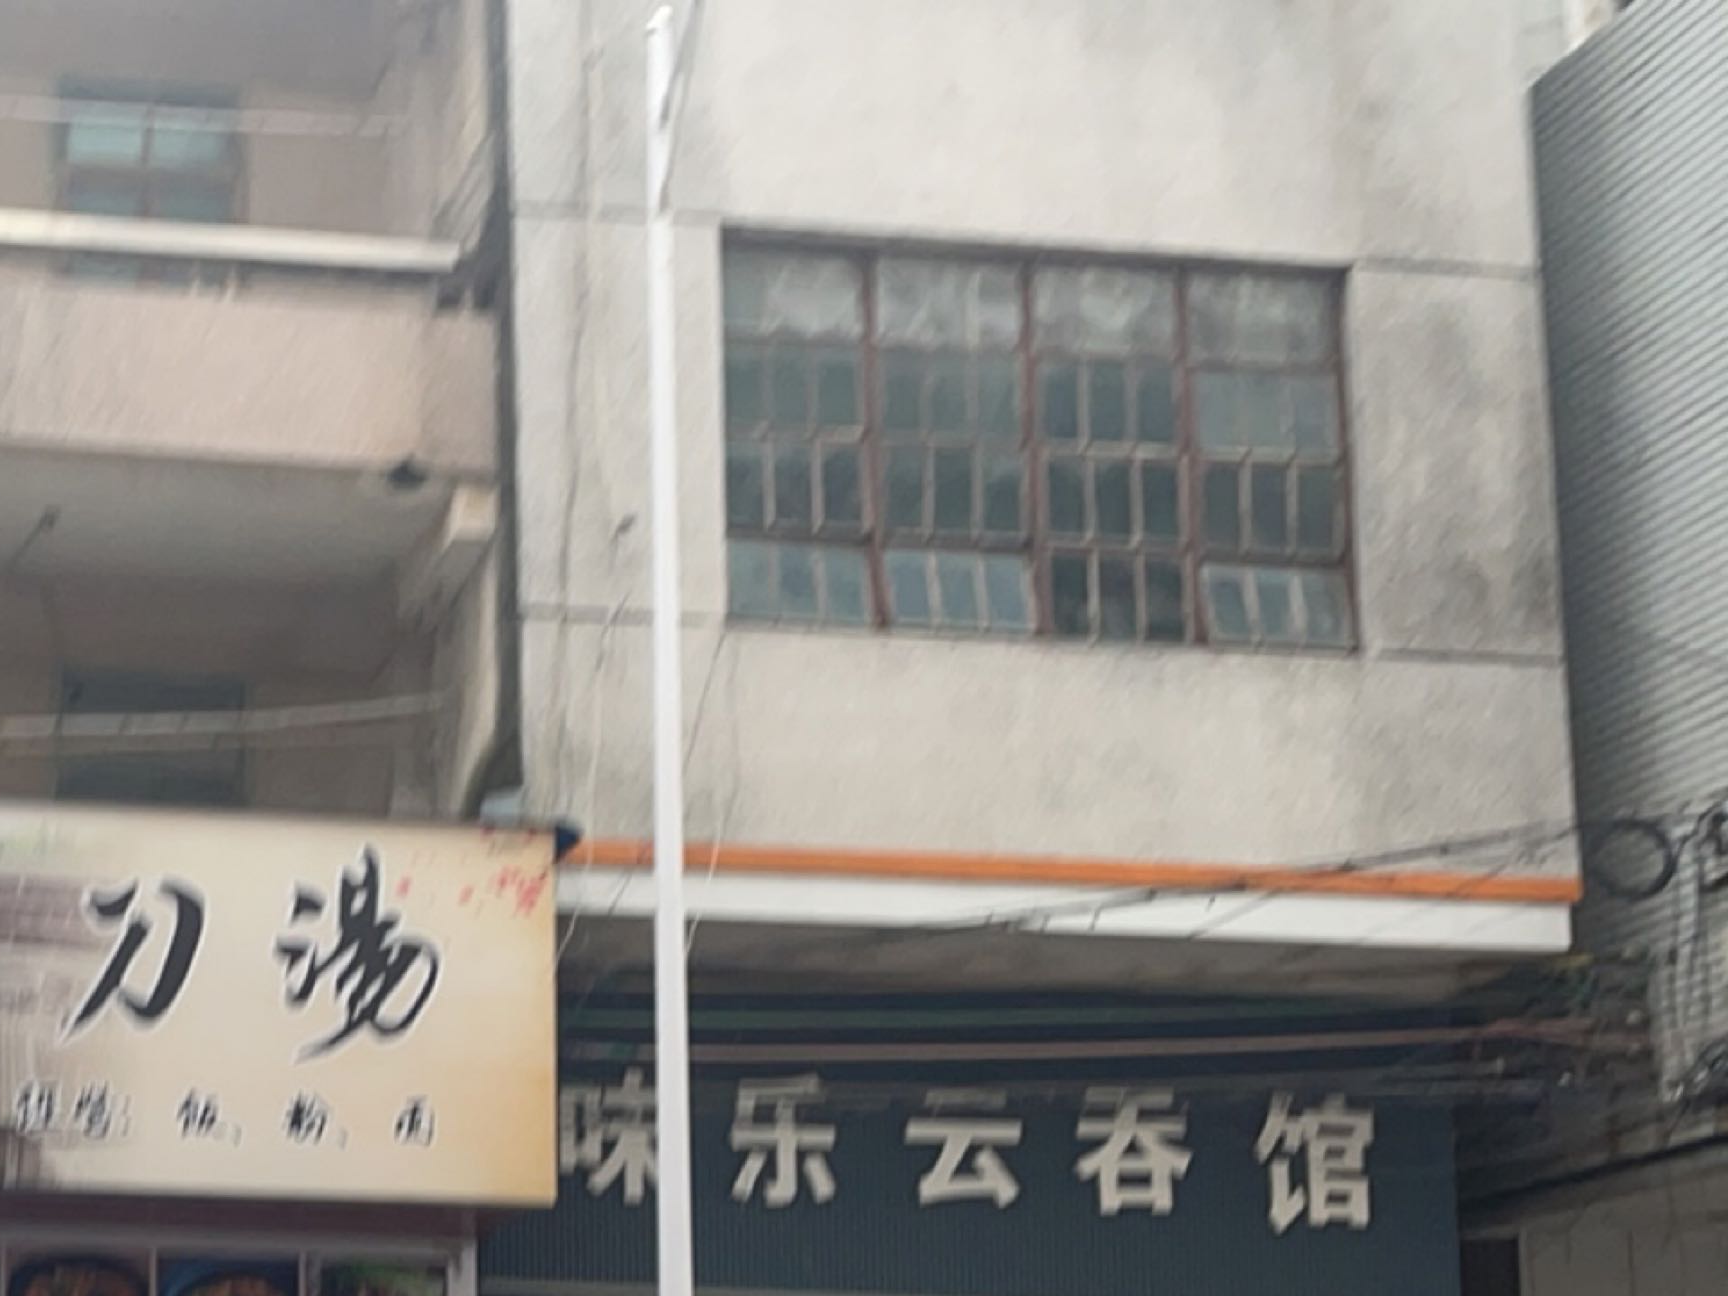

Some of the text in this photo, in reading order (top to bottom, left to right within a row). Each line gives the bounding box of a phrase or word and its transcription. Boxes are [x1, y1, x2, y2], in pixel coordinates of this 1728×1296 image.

[559, 1068, 1376, 1235] 味乐云吞馆
